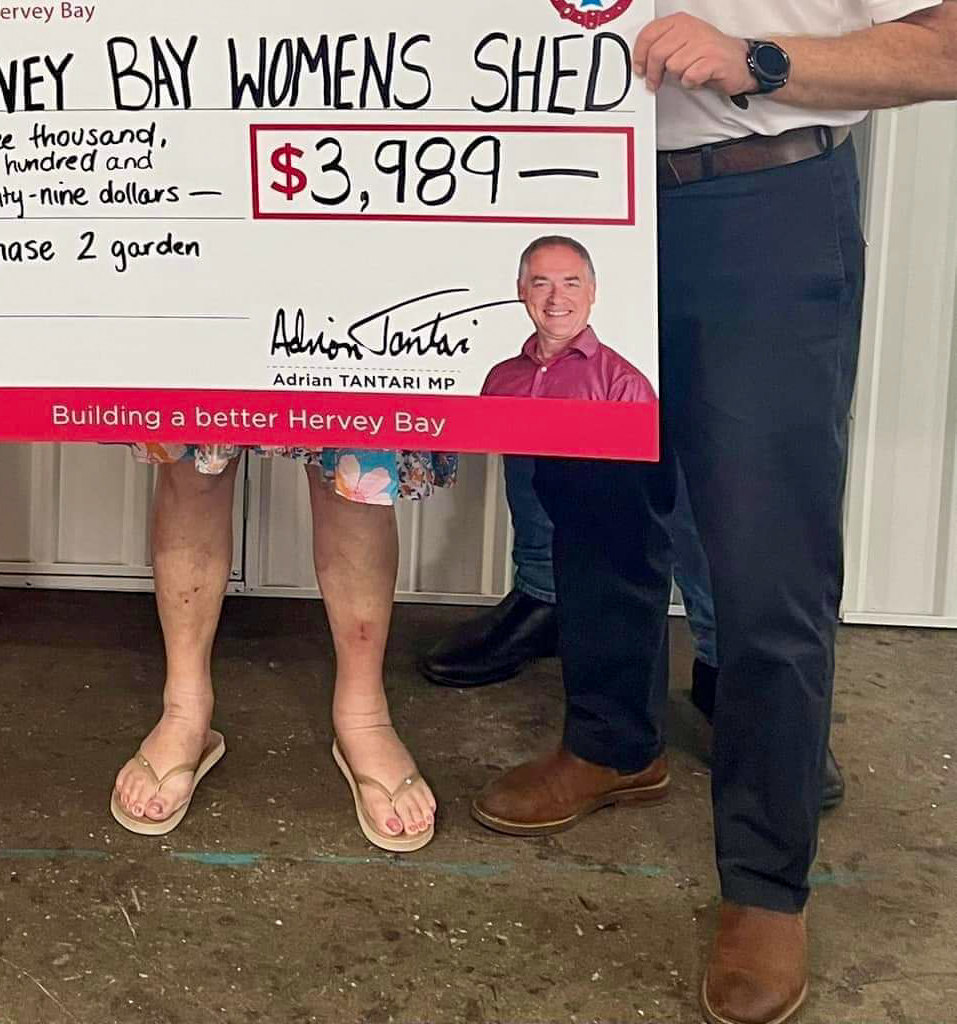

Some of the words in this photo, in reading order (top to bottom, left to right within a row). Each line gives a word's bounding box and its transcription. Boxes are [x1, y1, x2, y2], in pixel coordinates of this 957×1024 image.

[61, 1, 95, 23] Bay
[106, 34, 197, 111] BAY
[227, 31, 432, 111] WOMENS
[471, 32, 632, 115] SHED
[29, 122, 166, 149] thousand,
[5, 149, 97, 175] hundred
[106, 149, 153, 171] and
[270, 135, 501, 212] $3,989
[99, 180, 179, 206] dollars
[77, 231, 97, 259] 2
[111, 232, 200, 272] garden
[273, 373, 332, 387] Adrian
[339, 374, 420, 390] TANTARI
[428, 376, 455, 391] MP
[52, 404, 161, 430] Building
[171, 411, 185, 426] a
[195, 406, 277, 428] better
[288, 408, 384, 434] Hervey
[395, 411, 445, 437] Bay
